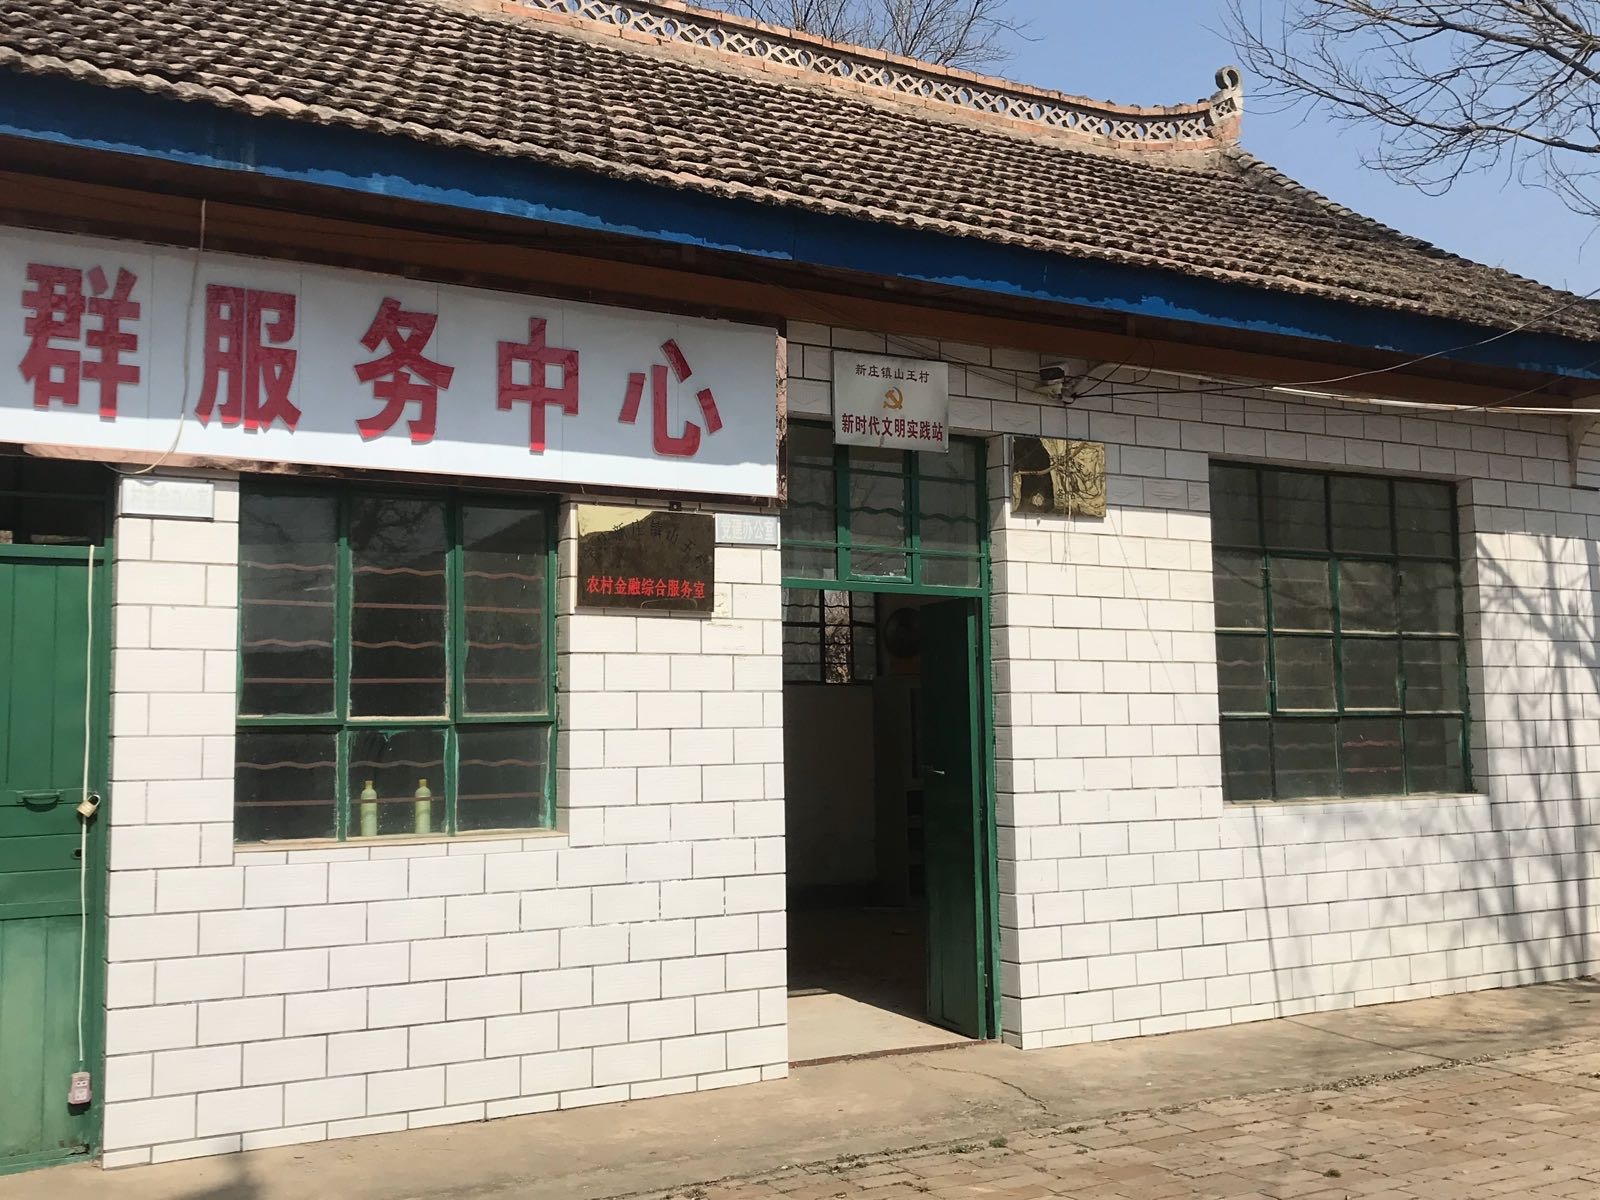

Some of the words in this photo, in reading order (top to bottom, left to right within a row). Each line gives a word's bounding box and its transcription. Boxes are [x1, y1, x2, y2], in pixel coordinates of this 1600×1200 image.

[18, 262, 723, 457] 群服务中心
[856, 364, 930, 383] 新庄镇山王村
[841, 413, 943, 441] 新时代文明实践站
[586, 575, 706, 599] 农村金融综合服务室
